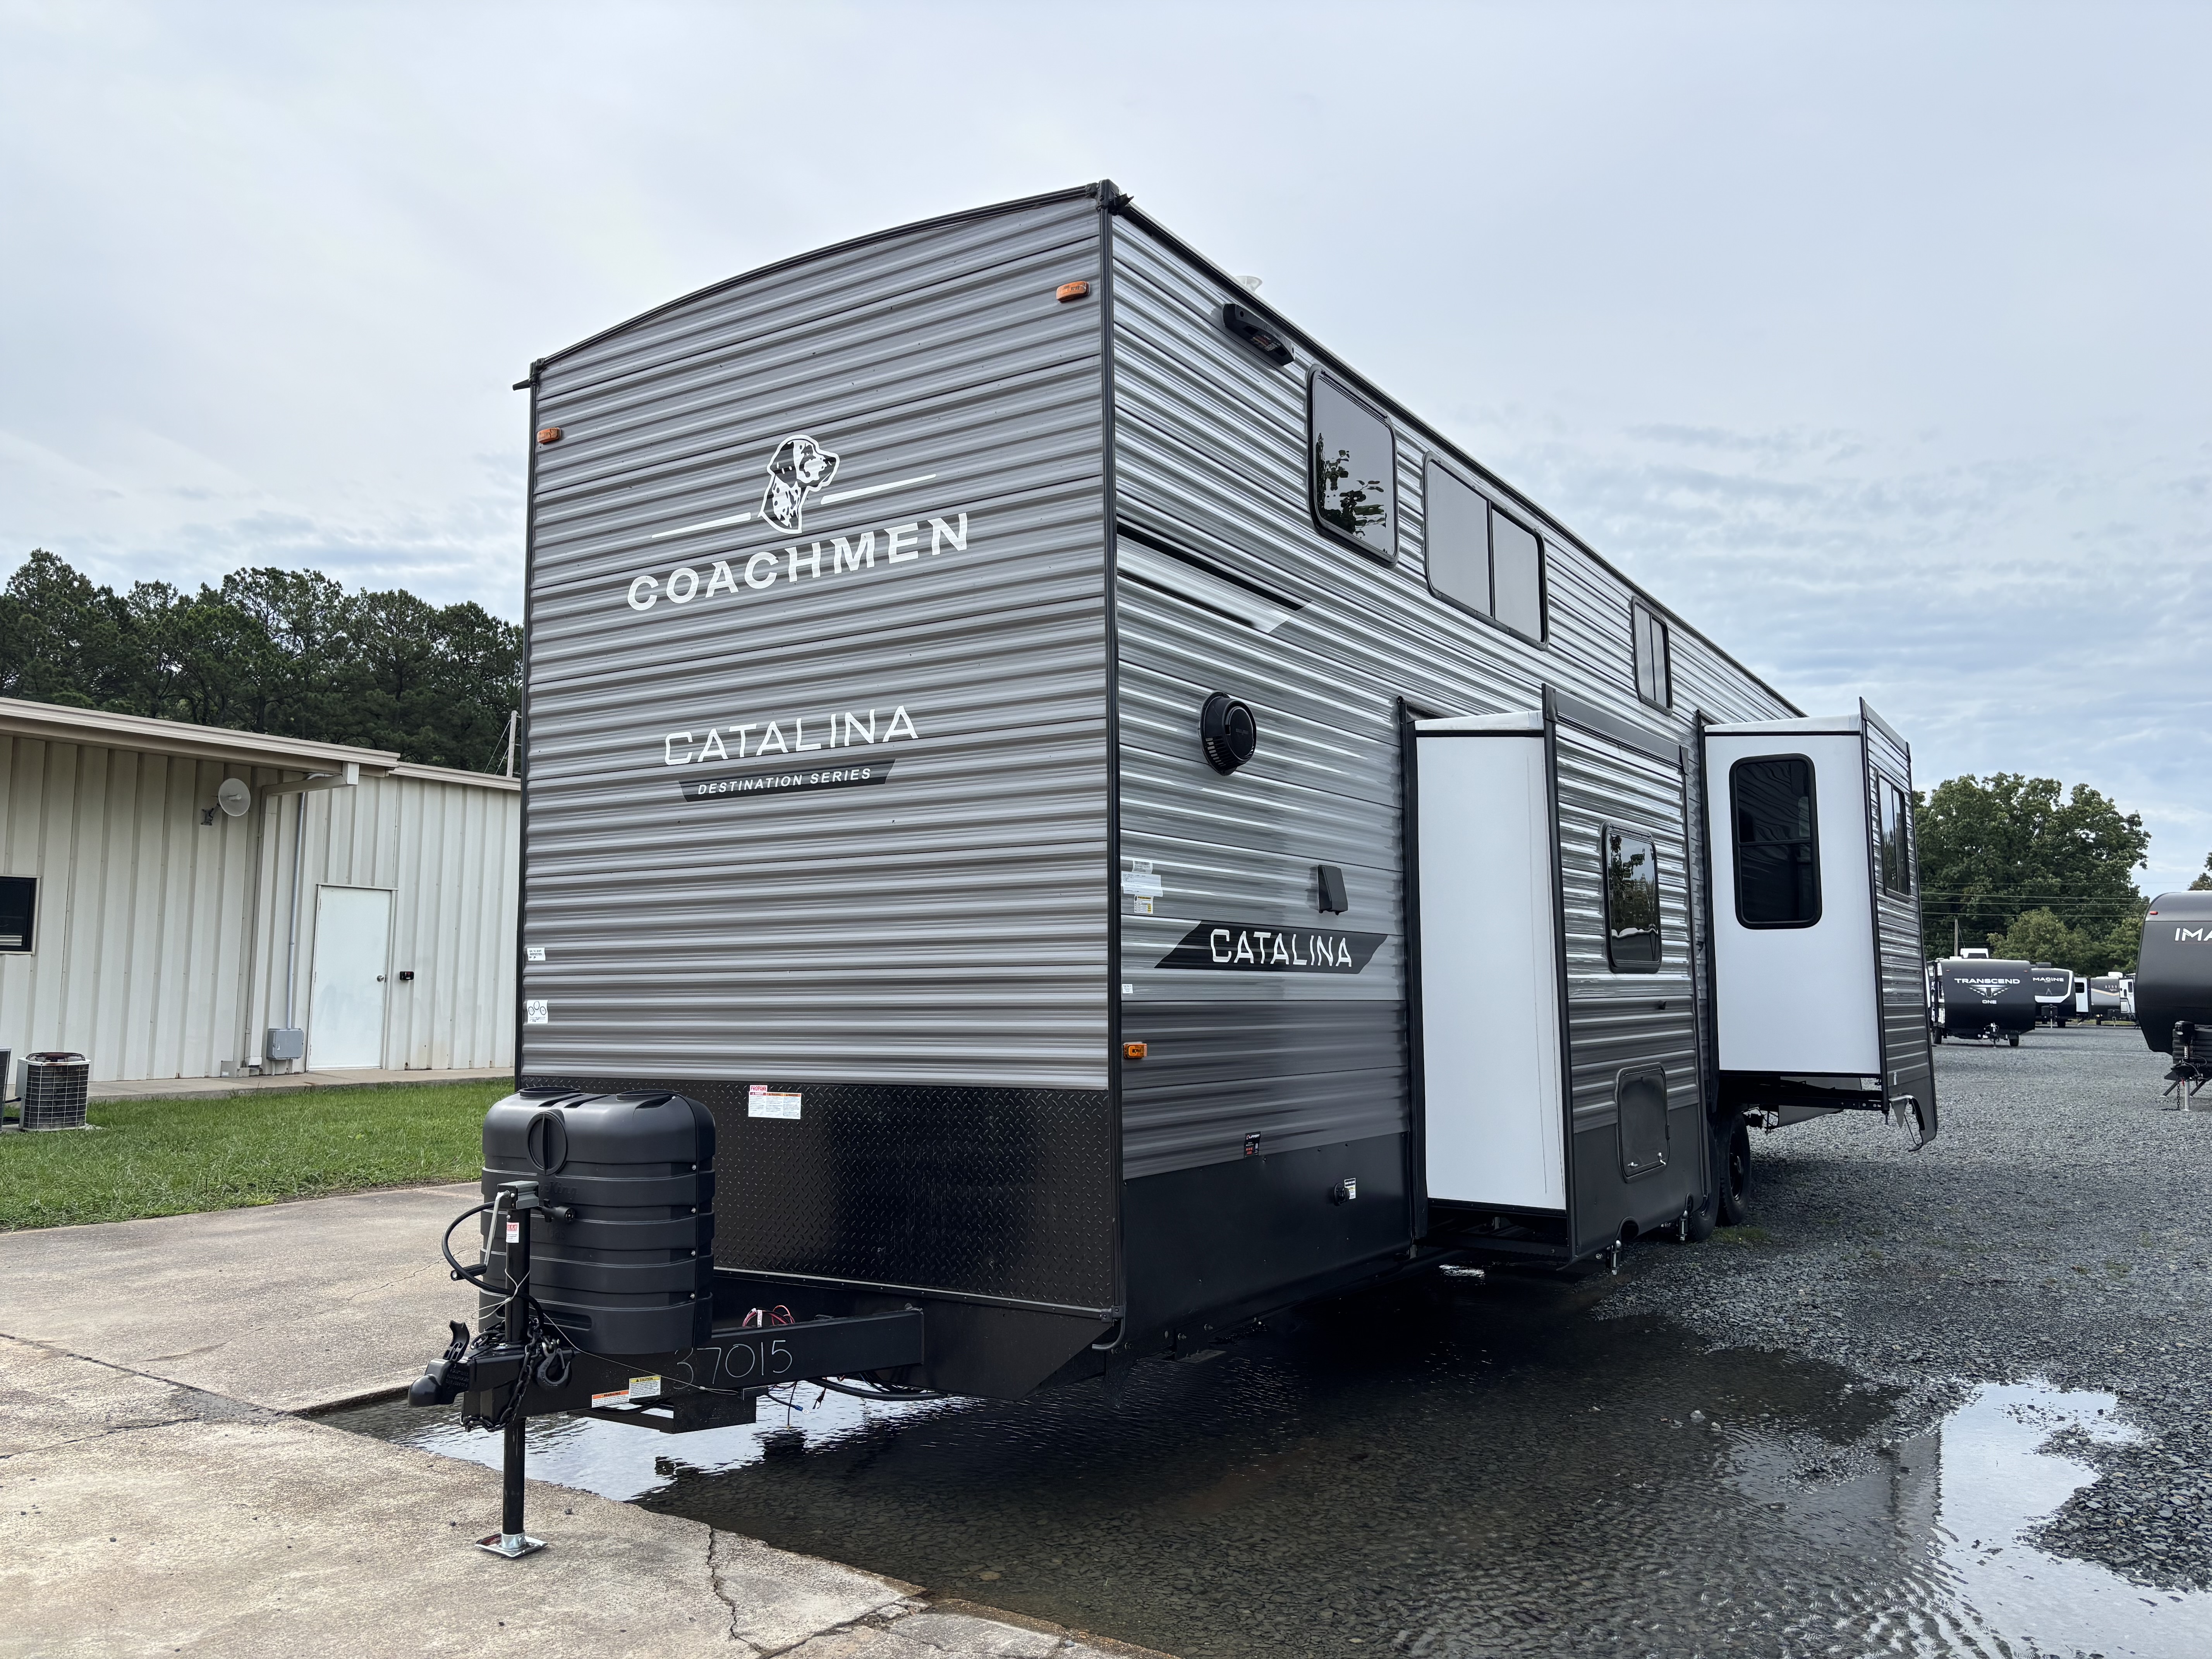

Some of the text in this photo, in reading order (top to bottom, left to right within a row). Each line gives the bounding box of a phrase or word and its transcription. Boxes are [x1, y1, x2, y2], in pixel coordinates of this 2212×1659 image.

[627, 512, 968, 611] COACHMEN
[664, 705, 919, 766] CATALINA
[697, 768, 871, 795] DESTINATION SERIES
[1210, 929, 1352, 967] CATALINA
[673, 1340, 793, 1389] 37015
